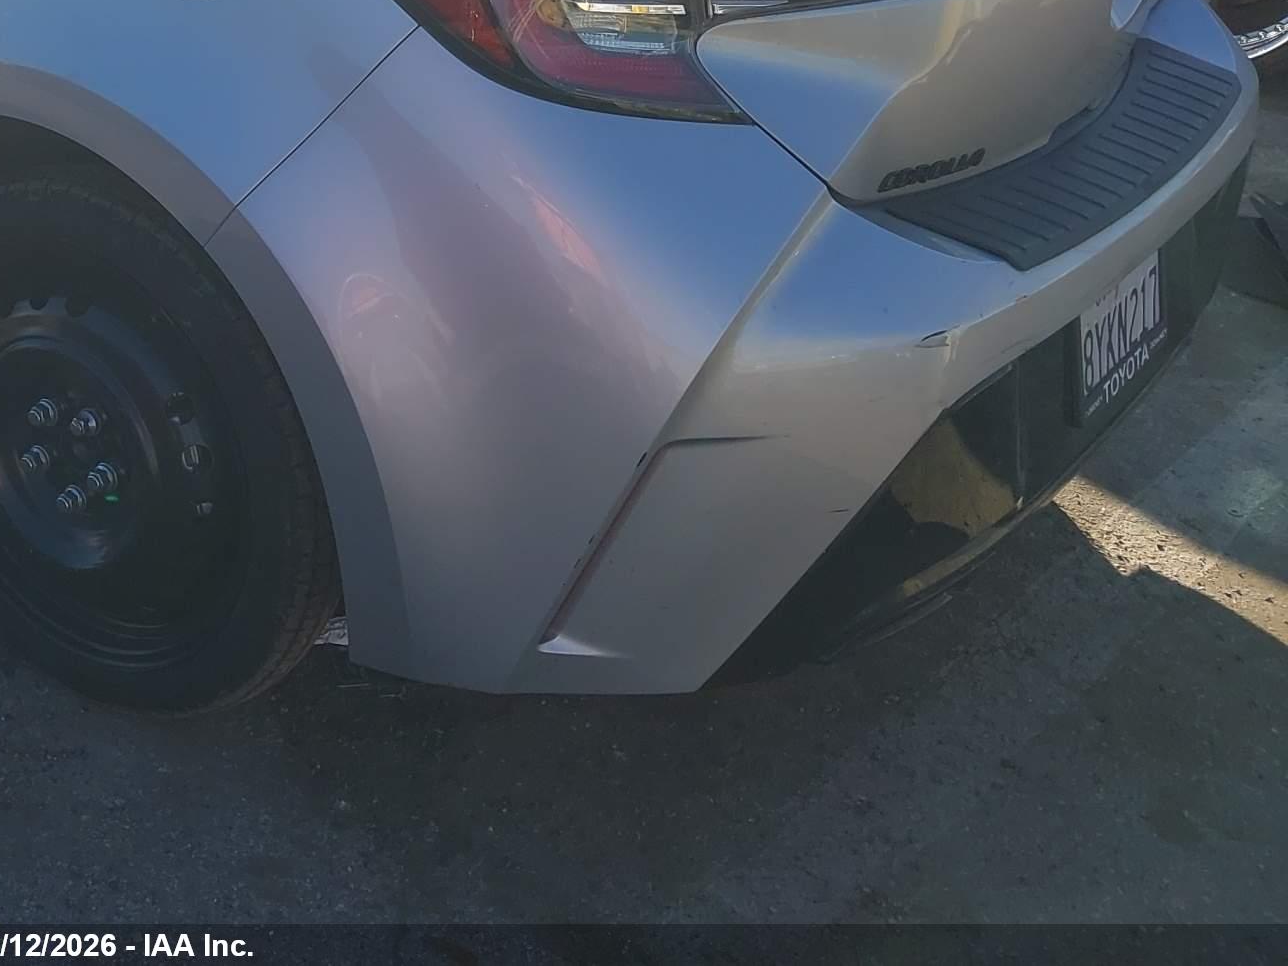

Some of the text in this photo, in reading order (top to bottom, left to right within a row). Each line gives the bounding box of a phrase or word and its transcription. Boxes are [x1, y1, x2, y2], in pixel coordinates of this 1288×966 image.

[877, 147, 986, 193] COROLLA
[1083, 265, 1159, 388] 8YXN217
[1103, 343, 1150, 404] TOYOTA
